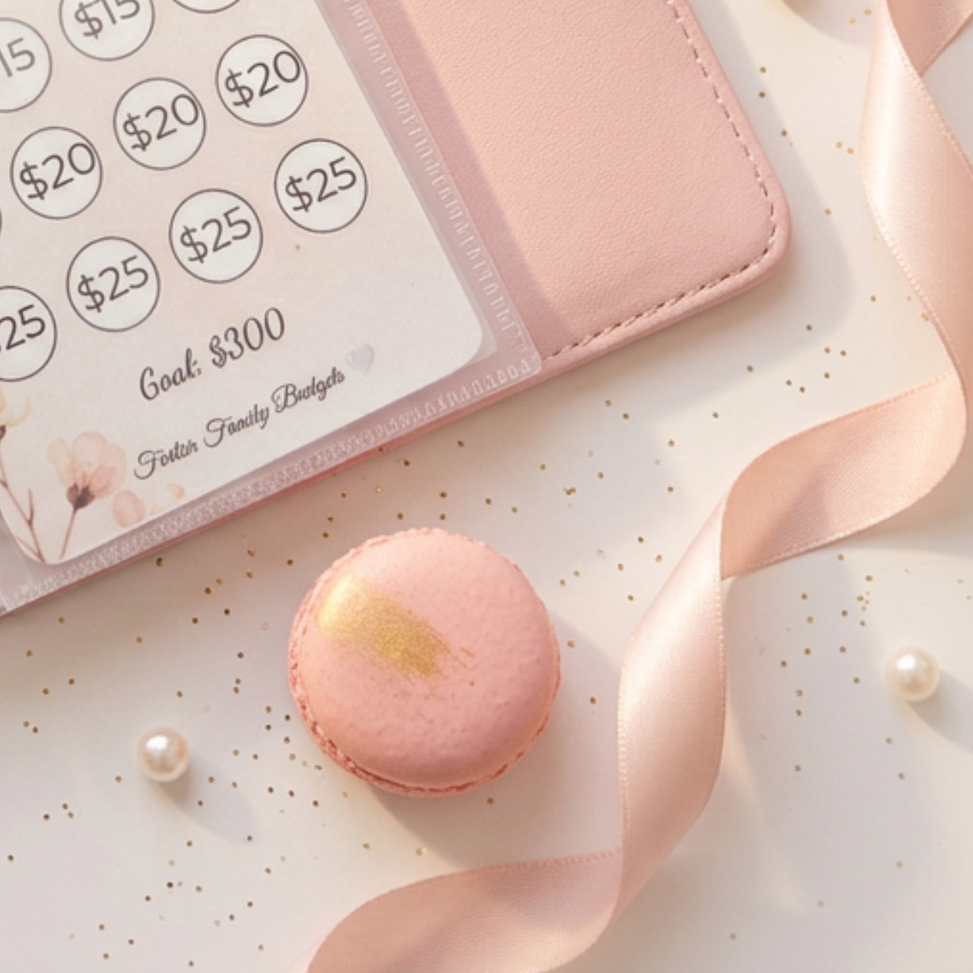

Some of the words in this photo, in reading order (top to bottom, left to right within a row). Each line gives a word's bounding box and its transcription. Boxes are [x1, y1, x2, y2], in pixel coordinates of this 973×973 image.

[19, 142, 96, 200] $20
[122, 94, 199, 152] $20
[224, 50, 301, 108] $20
[77, 255, 149, 313] $25
[180, 205, 252, 264] $25
[285, 156, 357, 213] $25
[139, 347, 202, 401] Goal:
[209, 307, 285, 369] $300
[203, 404, 269, 448] Family
